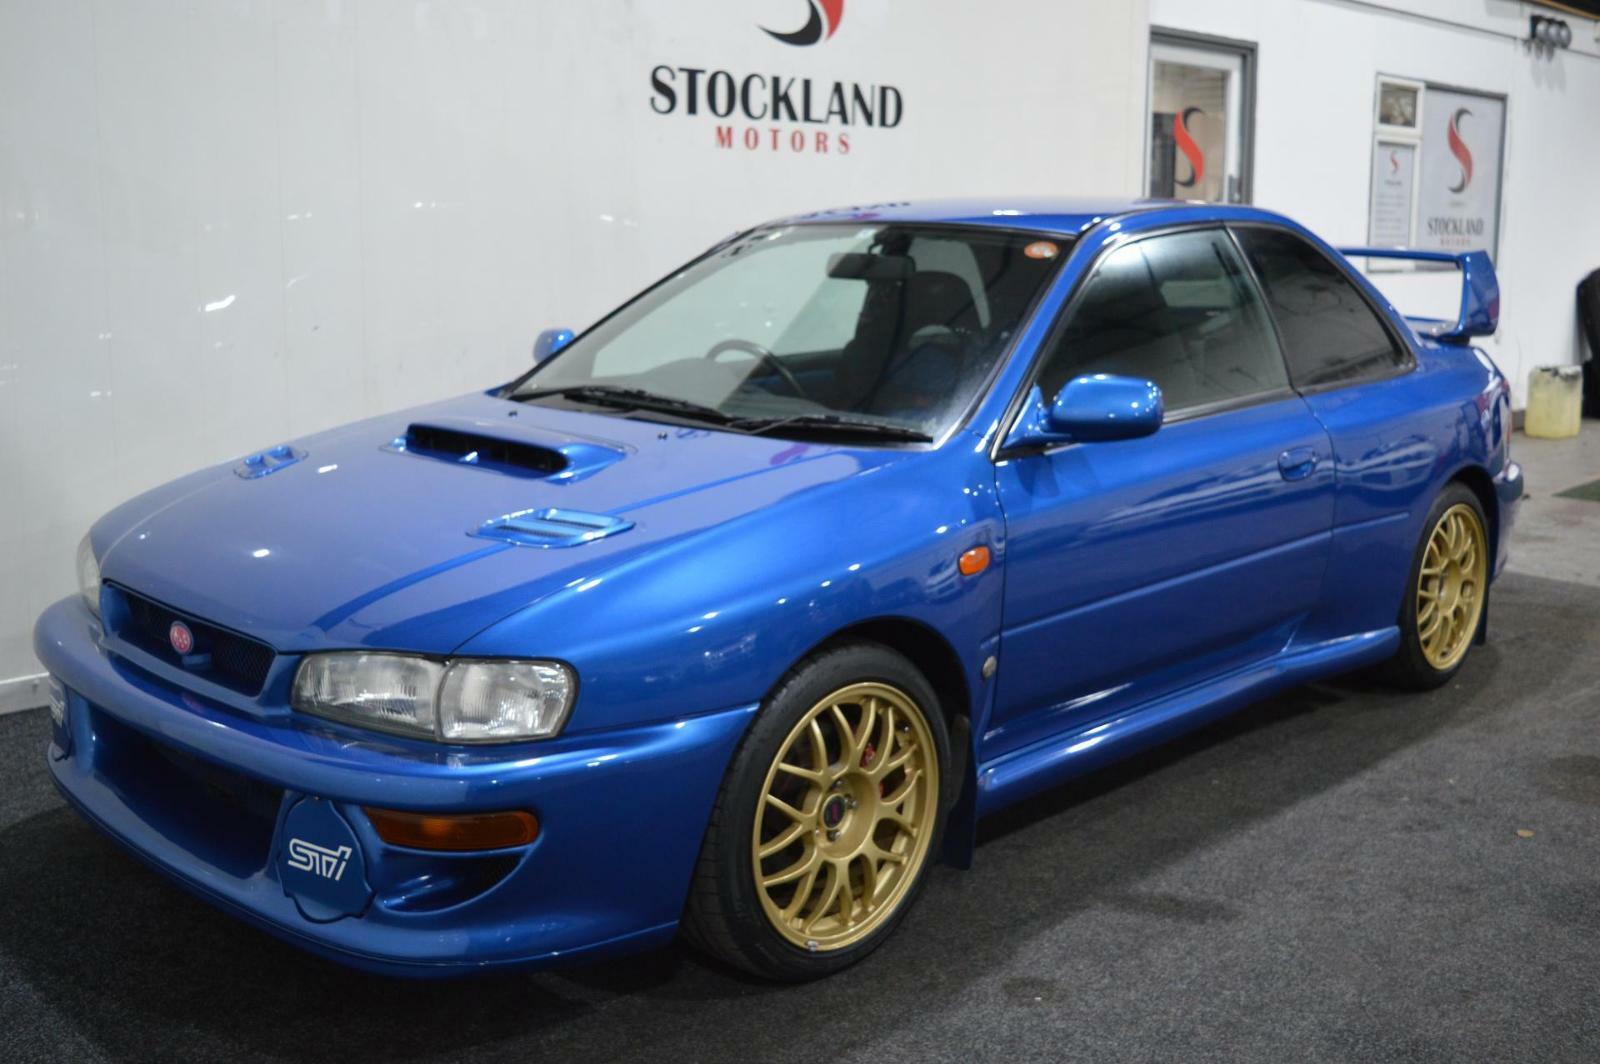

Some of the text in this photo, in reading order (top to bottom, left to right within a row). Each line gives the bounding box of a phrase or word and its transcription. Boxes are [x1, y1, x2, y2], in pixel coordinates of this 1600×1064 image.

[650, 65, 903, 128] STOCKLAND
[716, 126, 850, 154] MOTORS
[1427, 216, 1484, 236] STOCKLAND
